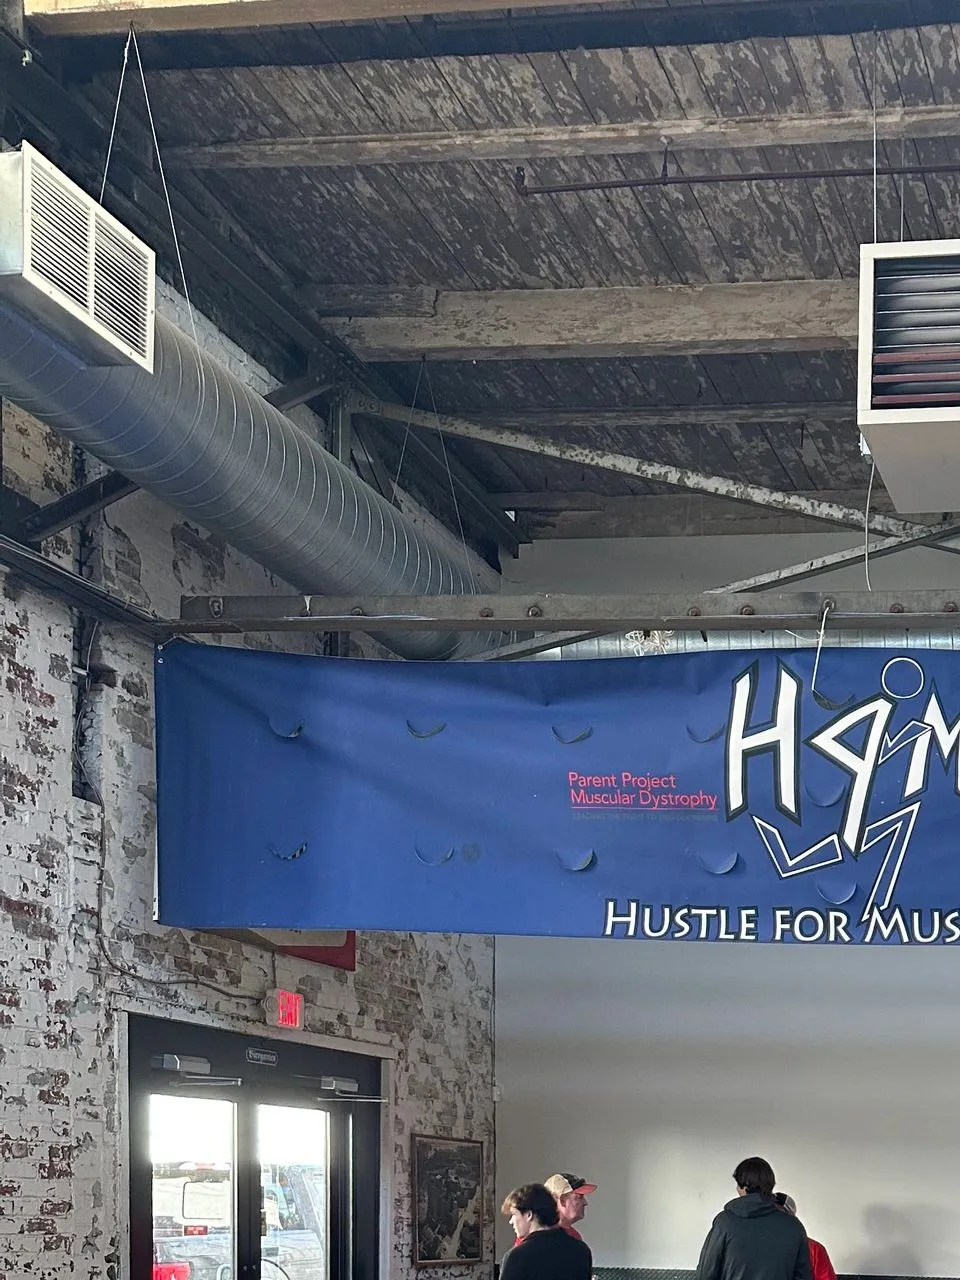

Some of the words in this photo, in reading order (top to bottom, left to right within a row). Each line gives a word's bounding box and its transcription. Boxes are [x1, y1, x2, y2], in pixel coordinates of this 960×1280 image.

[568, 772, 617, 788] Parent
[622, 772, 677, 791] Project
[570, 789, 635, 804] Muscular
[639, 790, 717, 810] Dystrophy
[603, 899, 758, 941] HUSTLE
[773, 907, 852, 943] FOR
[279, 989, 301, 1027] EXIT
